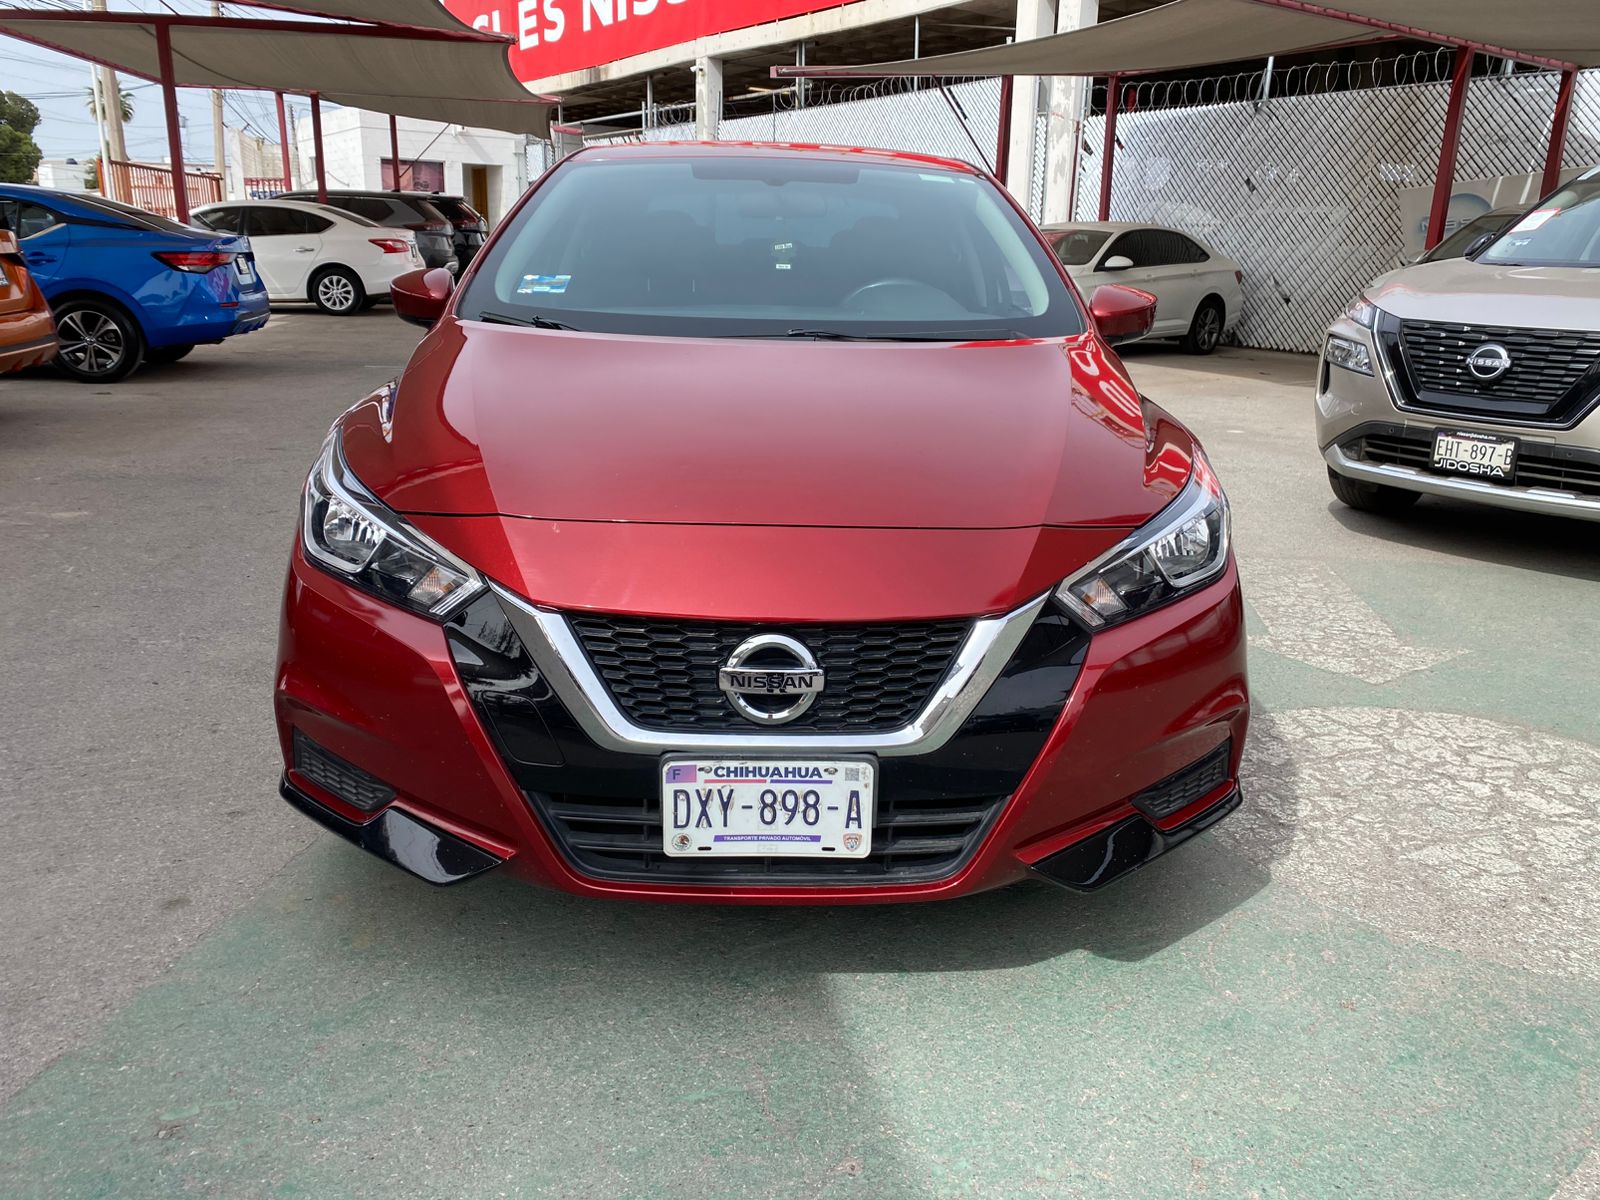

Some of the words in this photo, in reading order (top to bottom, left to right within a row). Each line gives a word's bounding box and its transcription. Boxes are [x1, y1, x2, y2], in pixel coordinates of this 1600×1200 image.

[1465, 357, 1511, 368] NISSAN
[1436, 440, 1513, 466] EHT-897-B
[1434, 458, 1505, 478] JIDOSHA
[730, 674, 814, 689] NISSAN
[672, 768, 681, 780] F
[713, 765, 823, 779] CHIHUAHUA
[673, 788, 862, 829] DXY-898-A
